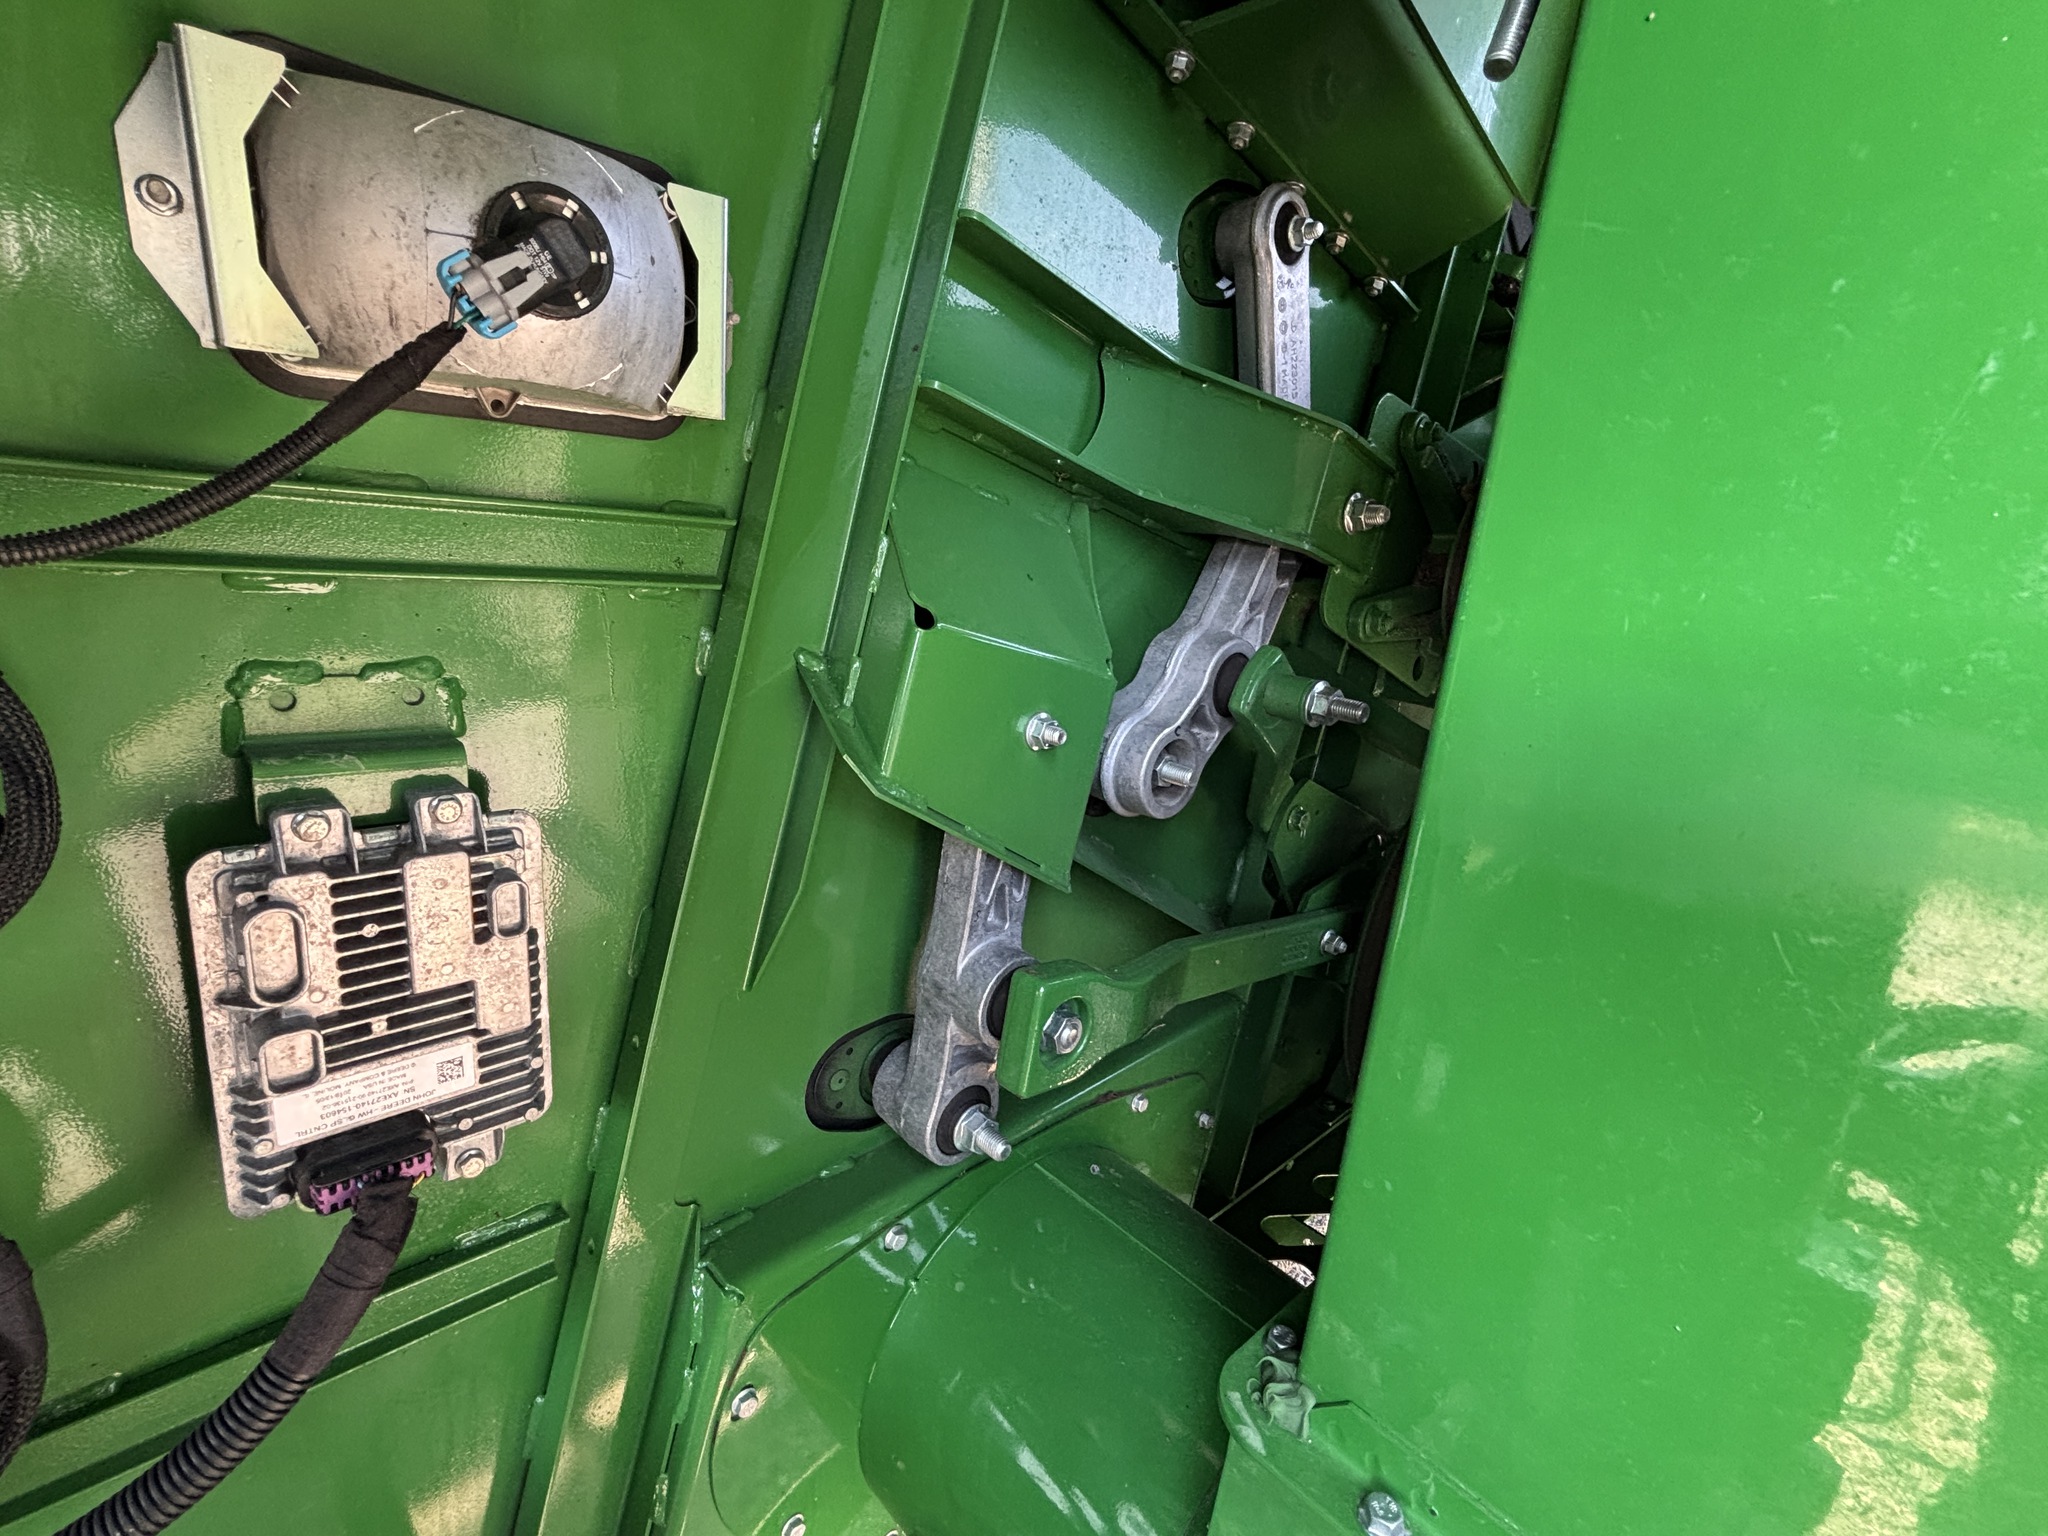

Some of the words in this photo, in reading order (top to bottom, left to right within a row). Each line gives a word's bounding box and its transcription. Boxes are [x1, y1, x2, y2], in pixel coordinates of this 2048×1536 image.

[526, 243, 537, 257] DOT
[533, 256, 543, 267] 12V
[386, 1064, 410, 1075] DEERE
[387, 1074, 407, 1083] MADE
[362, 1082, 377, 1090] USA
[412, 1089, 437, 1101] JOHN
[319, 1091, 399, 1120] AXE27140-154603
[380, 1097, 411, 1111] DEERE
[356, 1109, 374, 1119] HW
[294, 1123, 328, 1138] CNTRL
